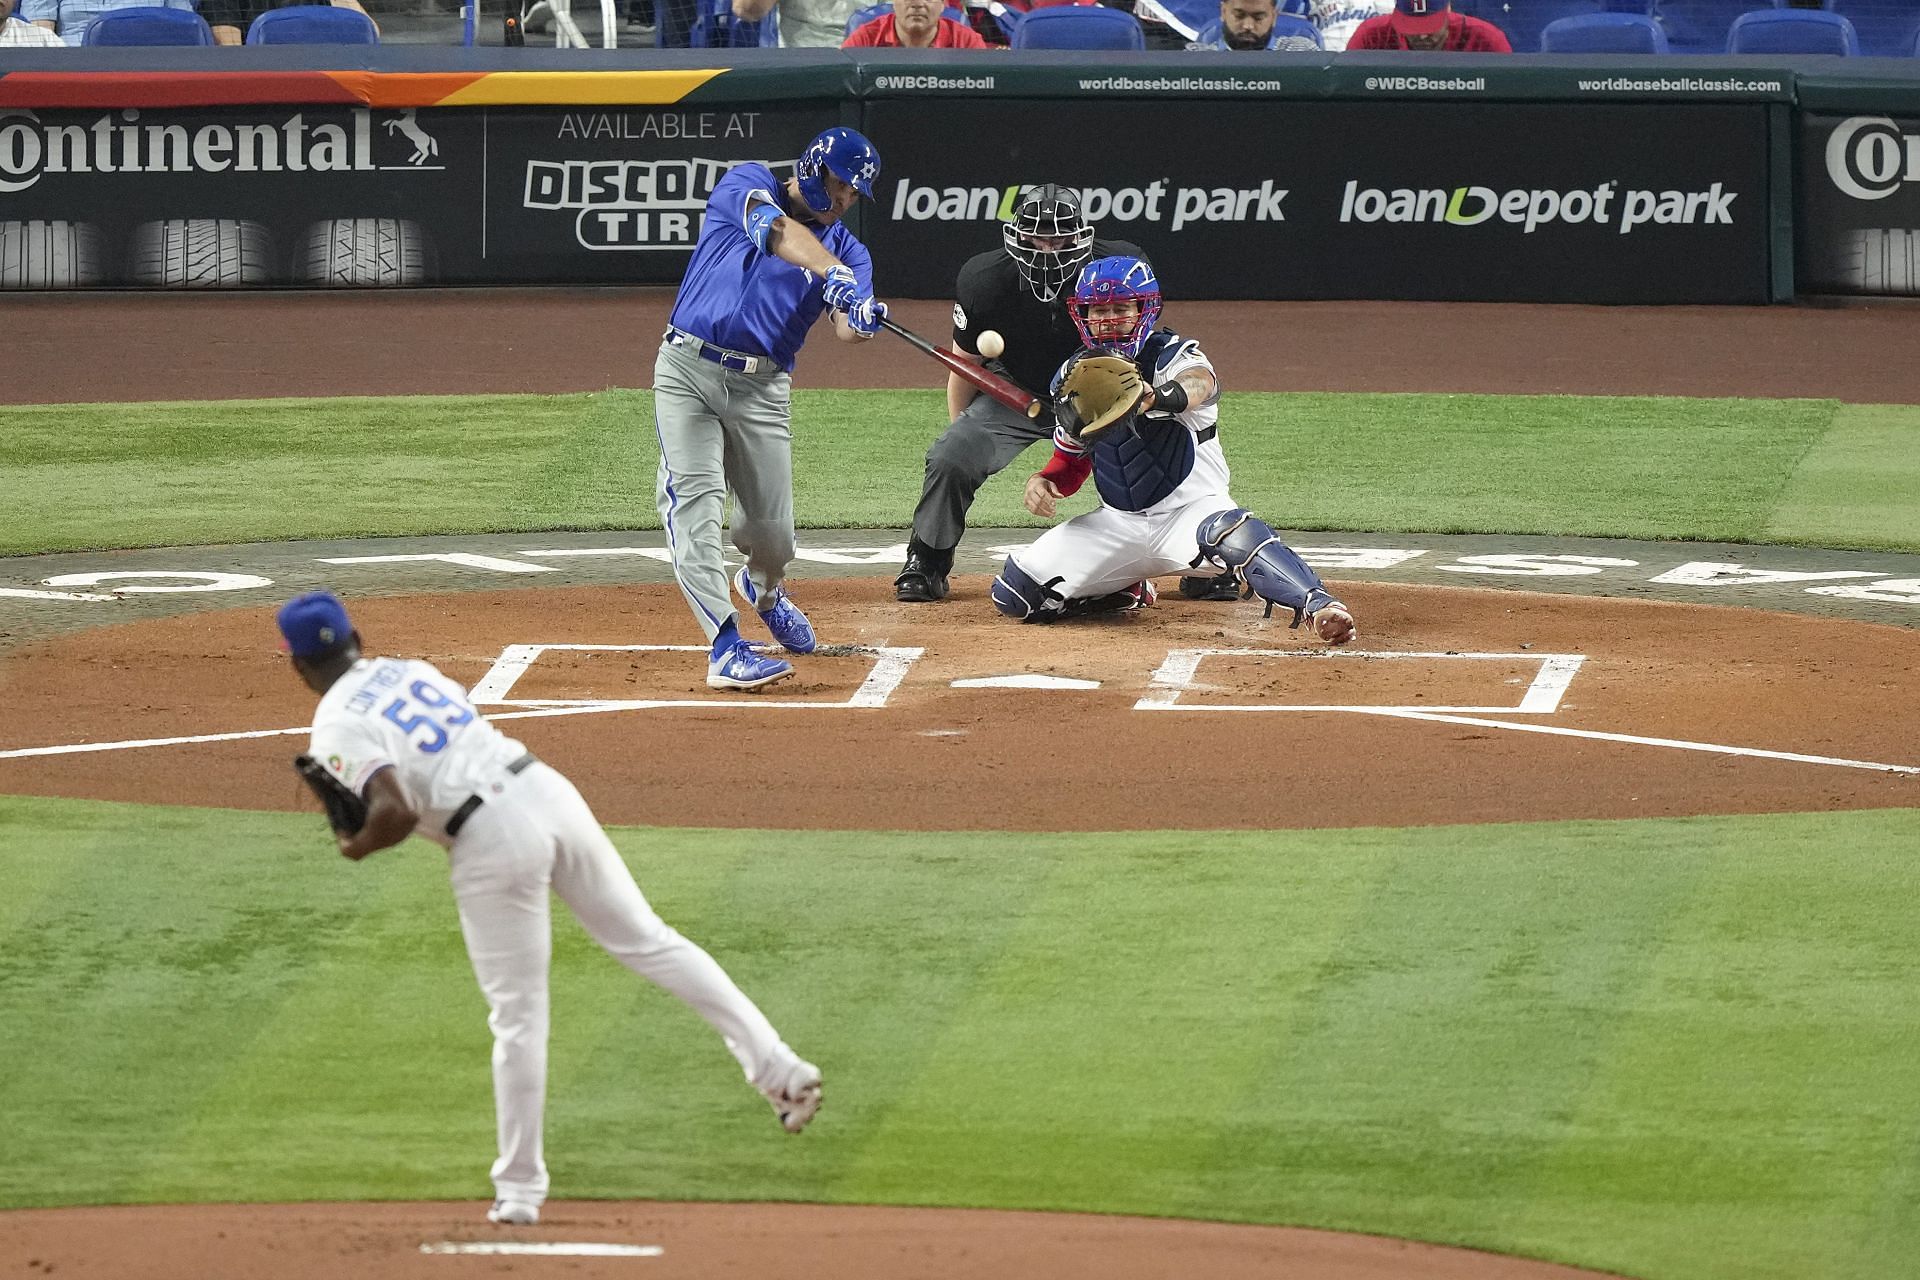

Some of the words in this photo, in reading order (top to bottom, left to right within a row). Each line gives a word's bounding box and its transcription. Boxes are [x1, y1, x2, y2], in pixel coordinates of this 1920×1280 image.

[875, 76, 995, 90] @WBCBaseball
[1079, 77, 1281, 92] worldbaseballclassic.com
[1364, 76, 1486, 92] @WBCBaseball
[1577, 77, 1782, 93] worldbaseballclassic.com
[557, 113, 716, 139] AVAILABLE
[724, 113, 760, 138] AT
[523, 157, 800, 210] DISCOU
[1171, 179, 1290, 232] park
[1339, 180, 1614, 234] loanDepot
[1620, 182, 1738, 234] park
[598, 212, 706, 242] TIR
[381, 679, 474, 754] 59
